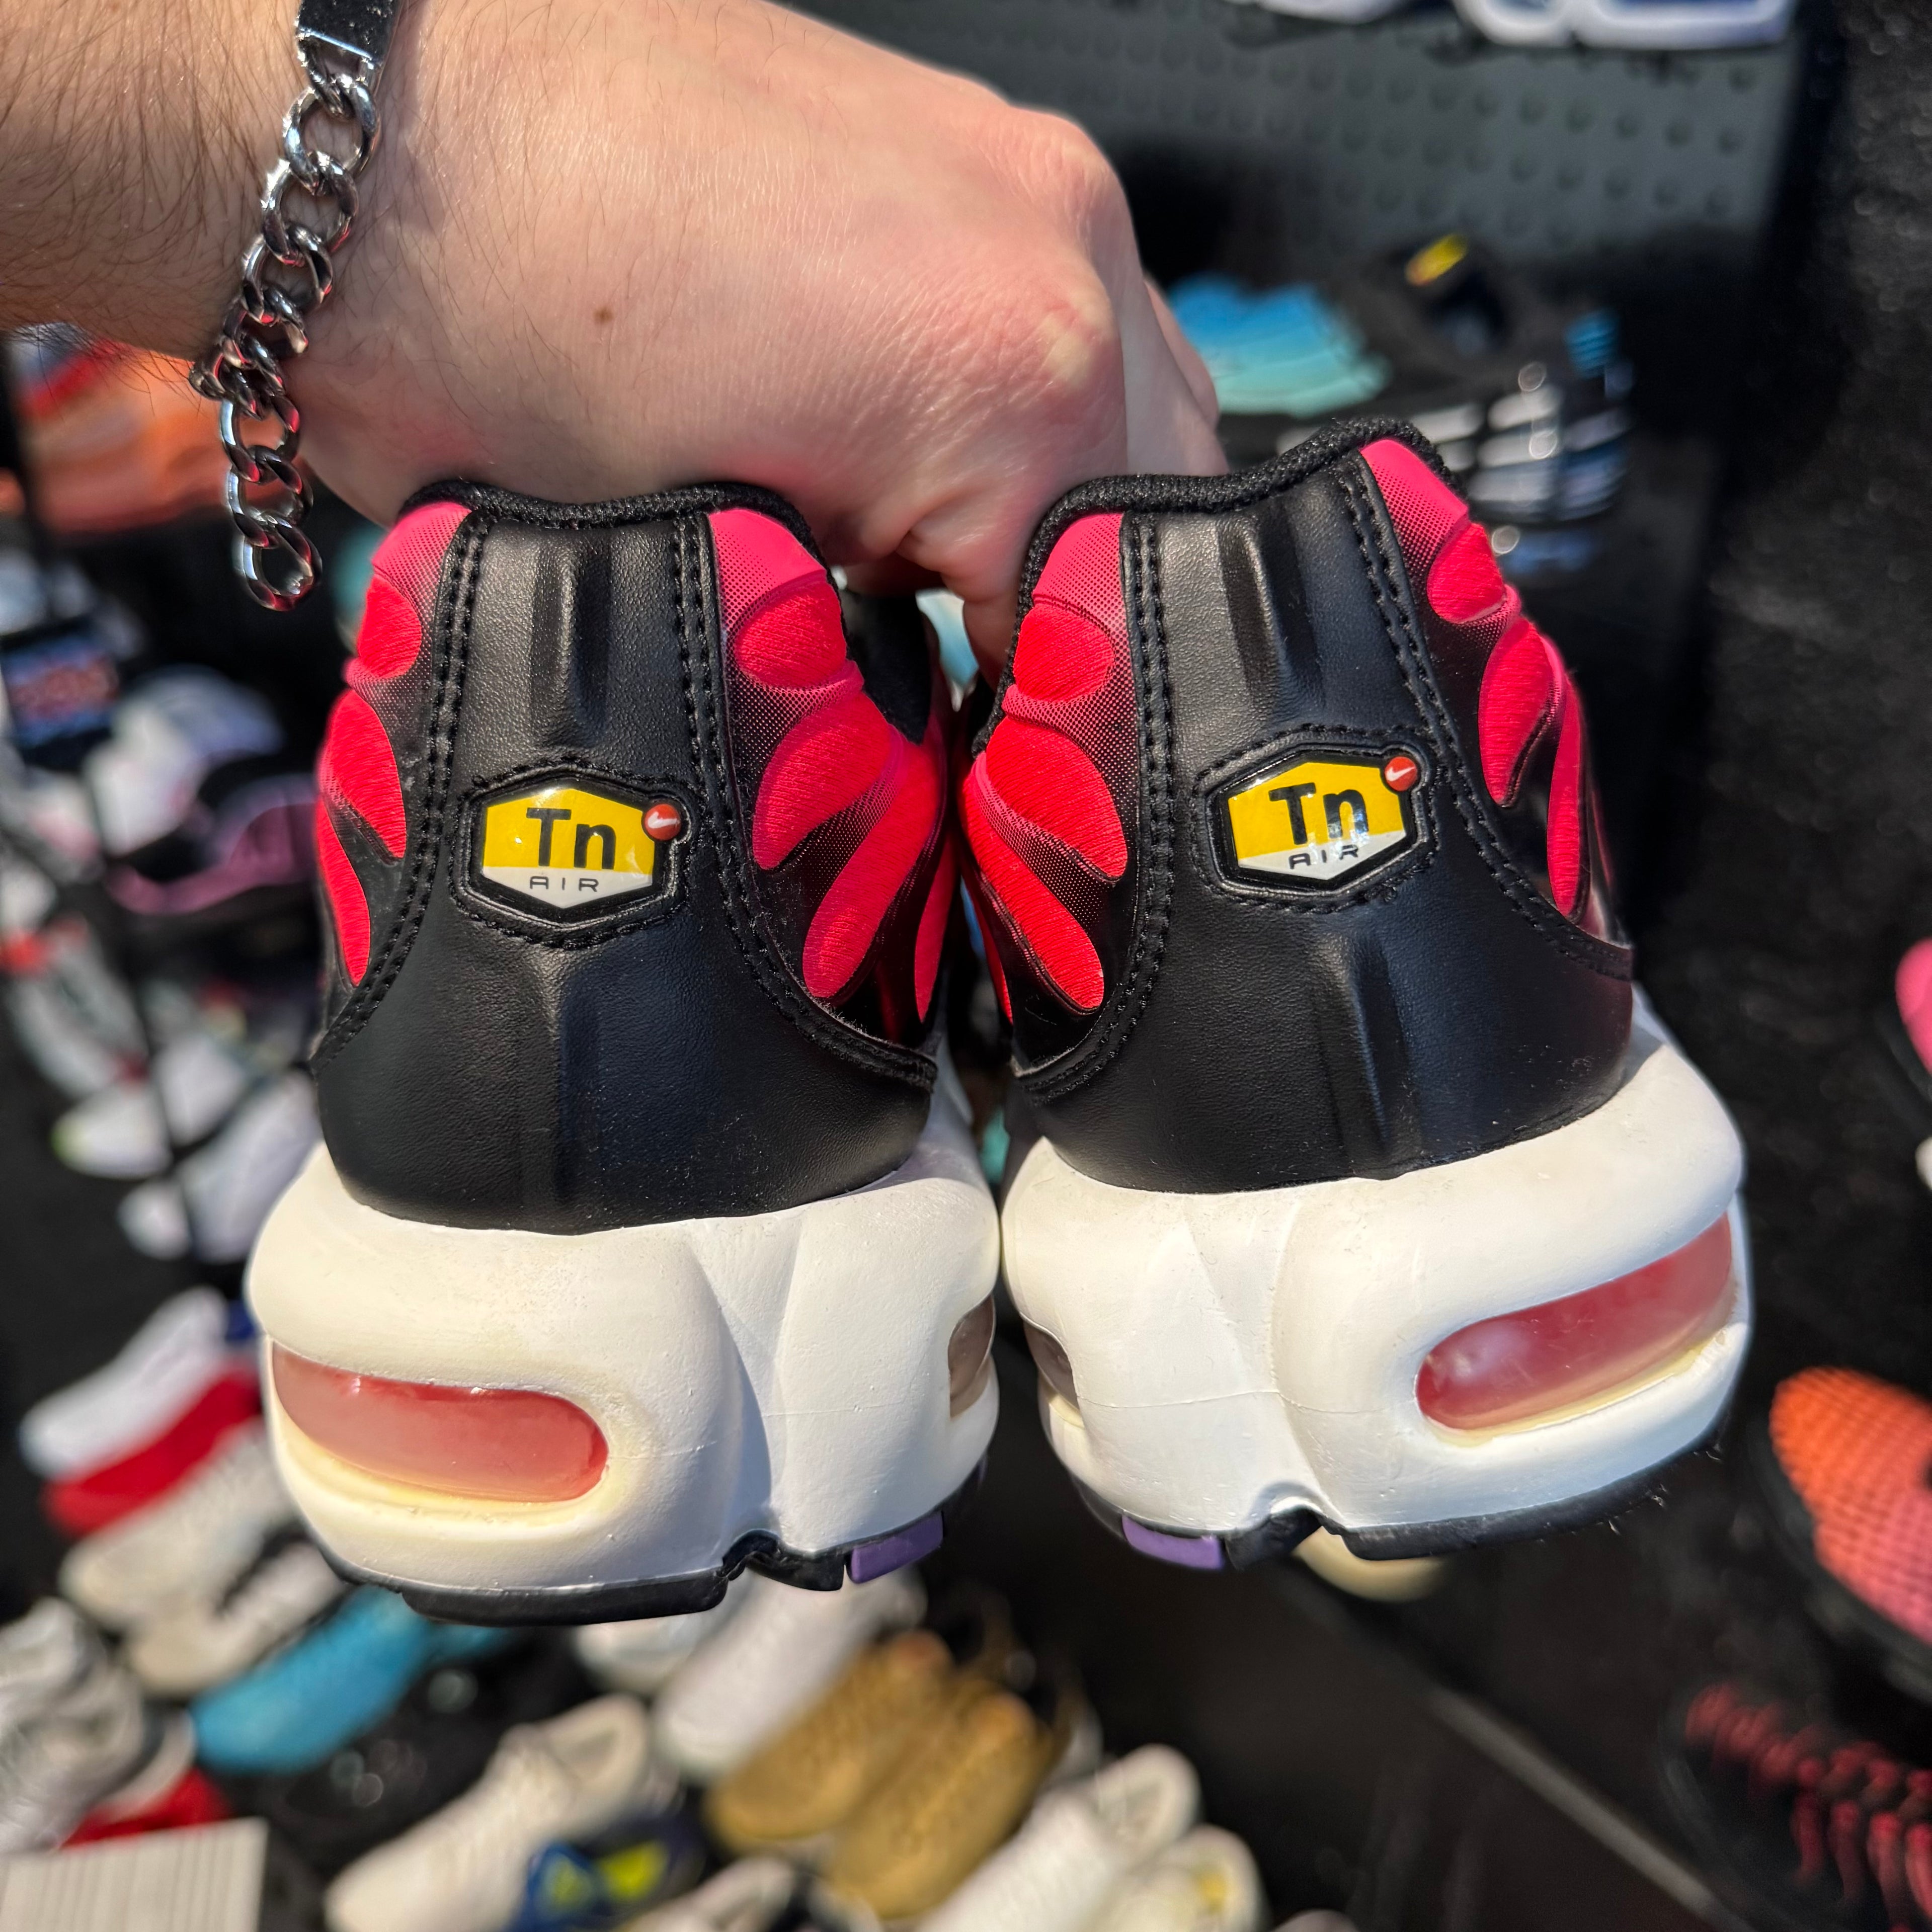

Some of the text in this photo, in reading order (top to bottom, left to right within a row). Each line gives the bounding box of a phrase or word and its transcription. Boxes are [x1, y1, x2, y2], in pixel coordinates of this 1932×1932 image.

[1269, 782, 1369, 845] Tn
[526, 807, 616, 870] Tn
[1289, 844, 1359, 869] AIR
[529, 875, 599, 892] AIR
